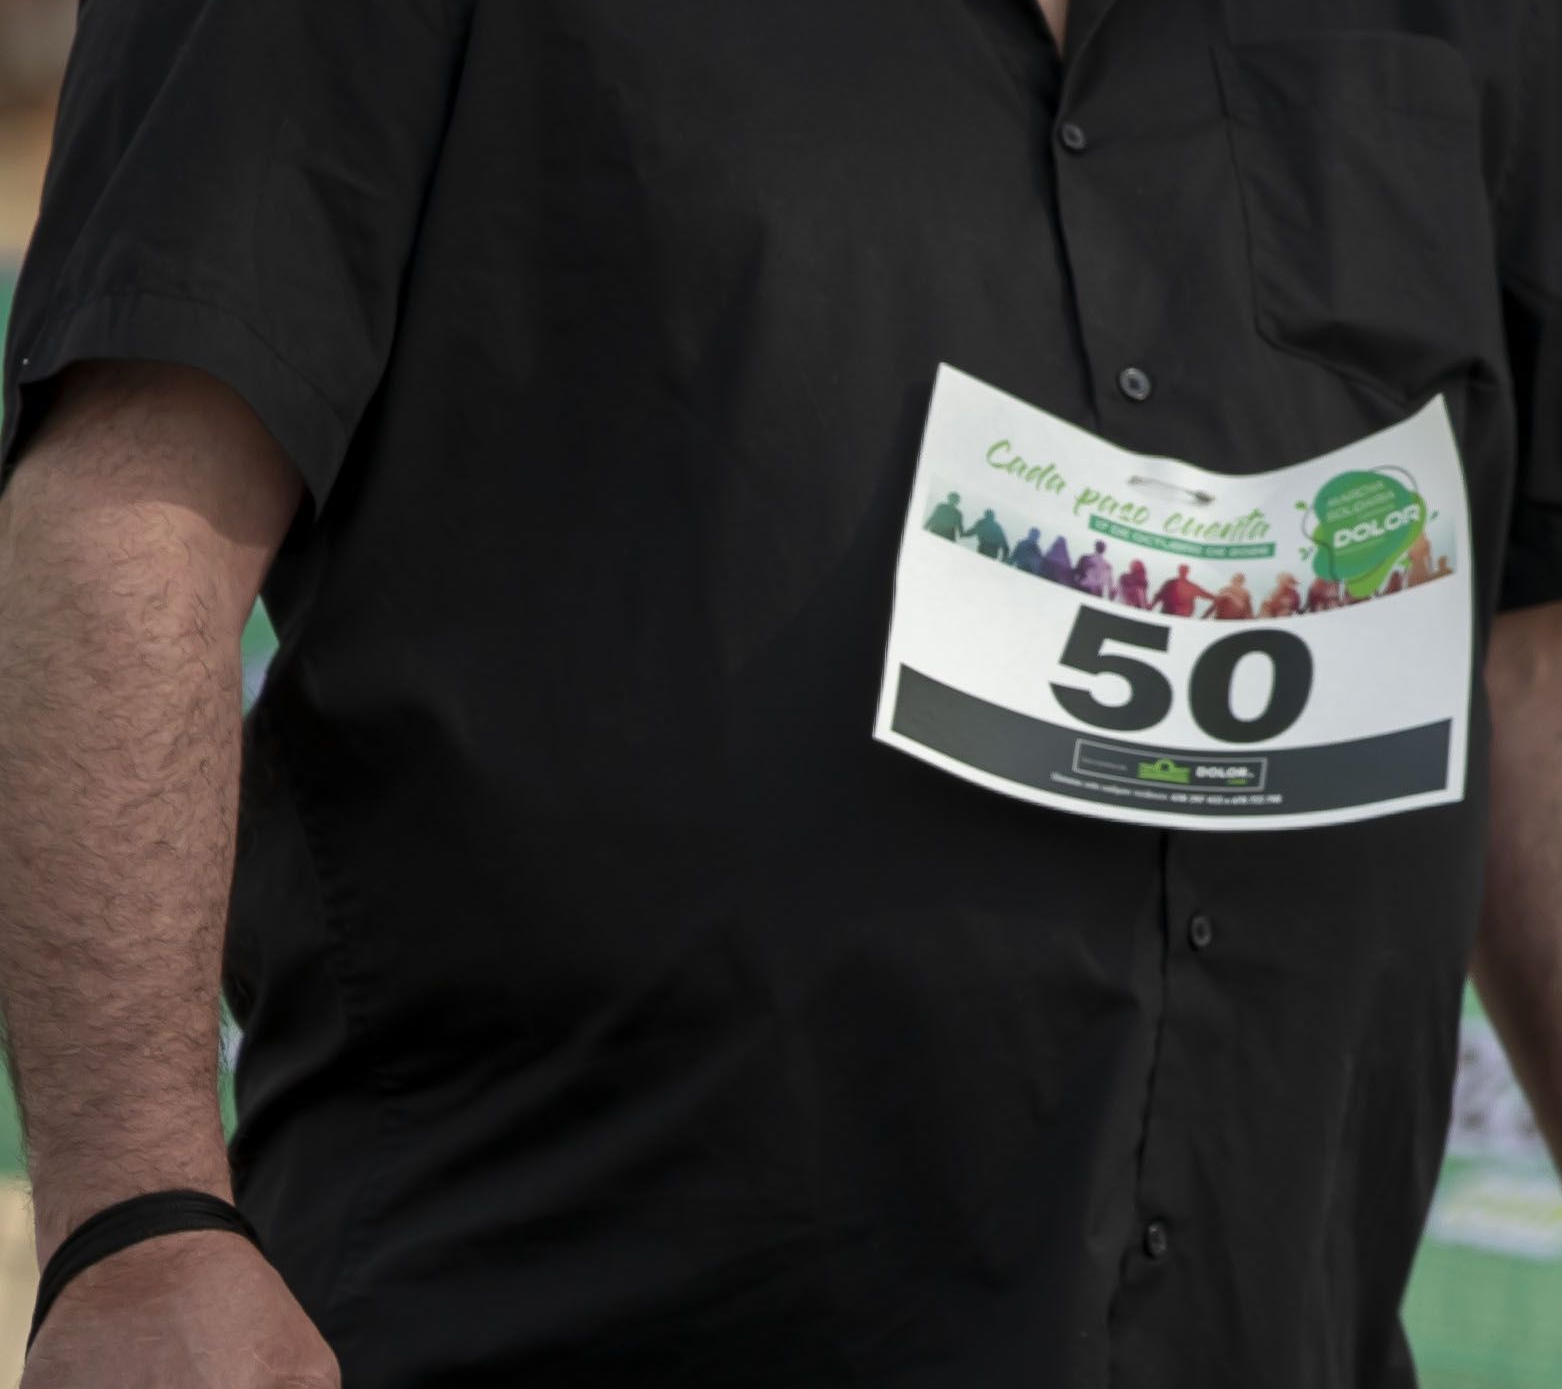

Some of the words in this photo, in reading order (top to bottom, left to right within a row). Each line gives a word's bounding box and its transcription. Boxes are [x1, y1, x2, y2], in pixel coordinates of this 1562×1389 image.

[986, 440, 1066, 495] Cada
[1073, 487, 1149, 525] paso
[1162, 508, 1270, 541] cuenta
[1333, 503, 1420, 548] DOLOR
[1049, 604, 1314, 743] 50
